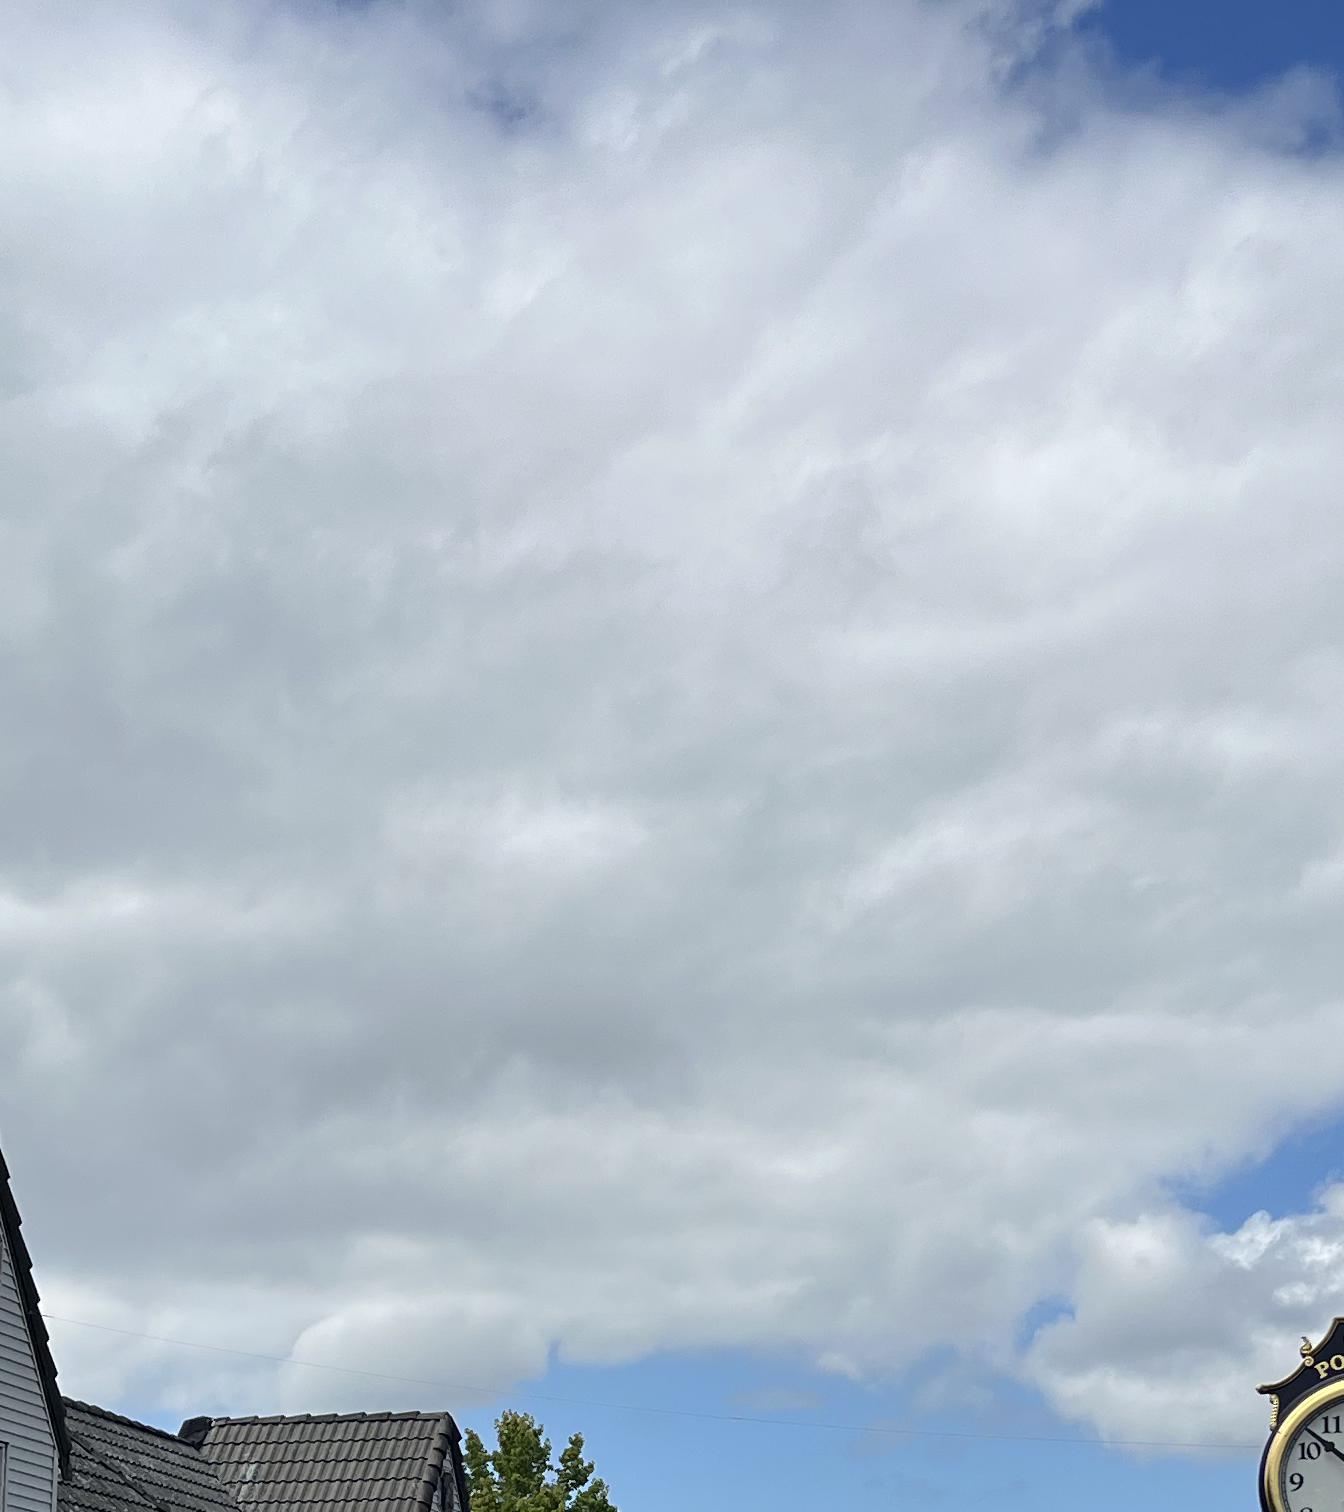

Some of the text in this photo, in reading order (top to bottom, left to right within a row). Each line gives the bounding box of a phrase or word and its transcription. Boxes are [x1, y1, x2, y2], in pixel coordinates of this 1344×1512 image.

[1322, 1416, 1342, 1434] 11
[1299, 1442, 1321, 1460] 10
[1289, 1473, 1304, 1491] 9
